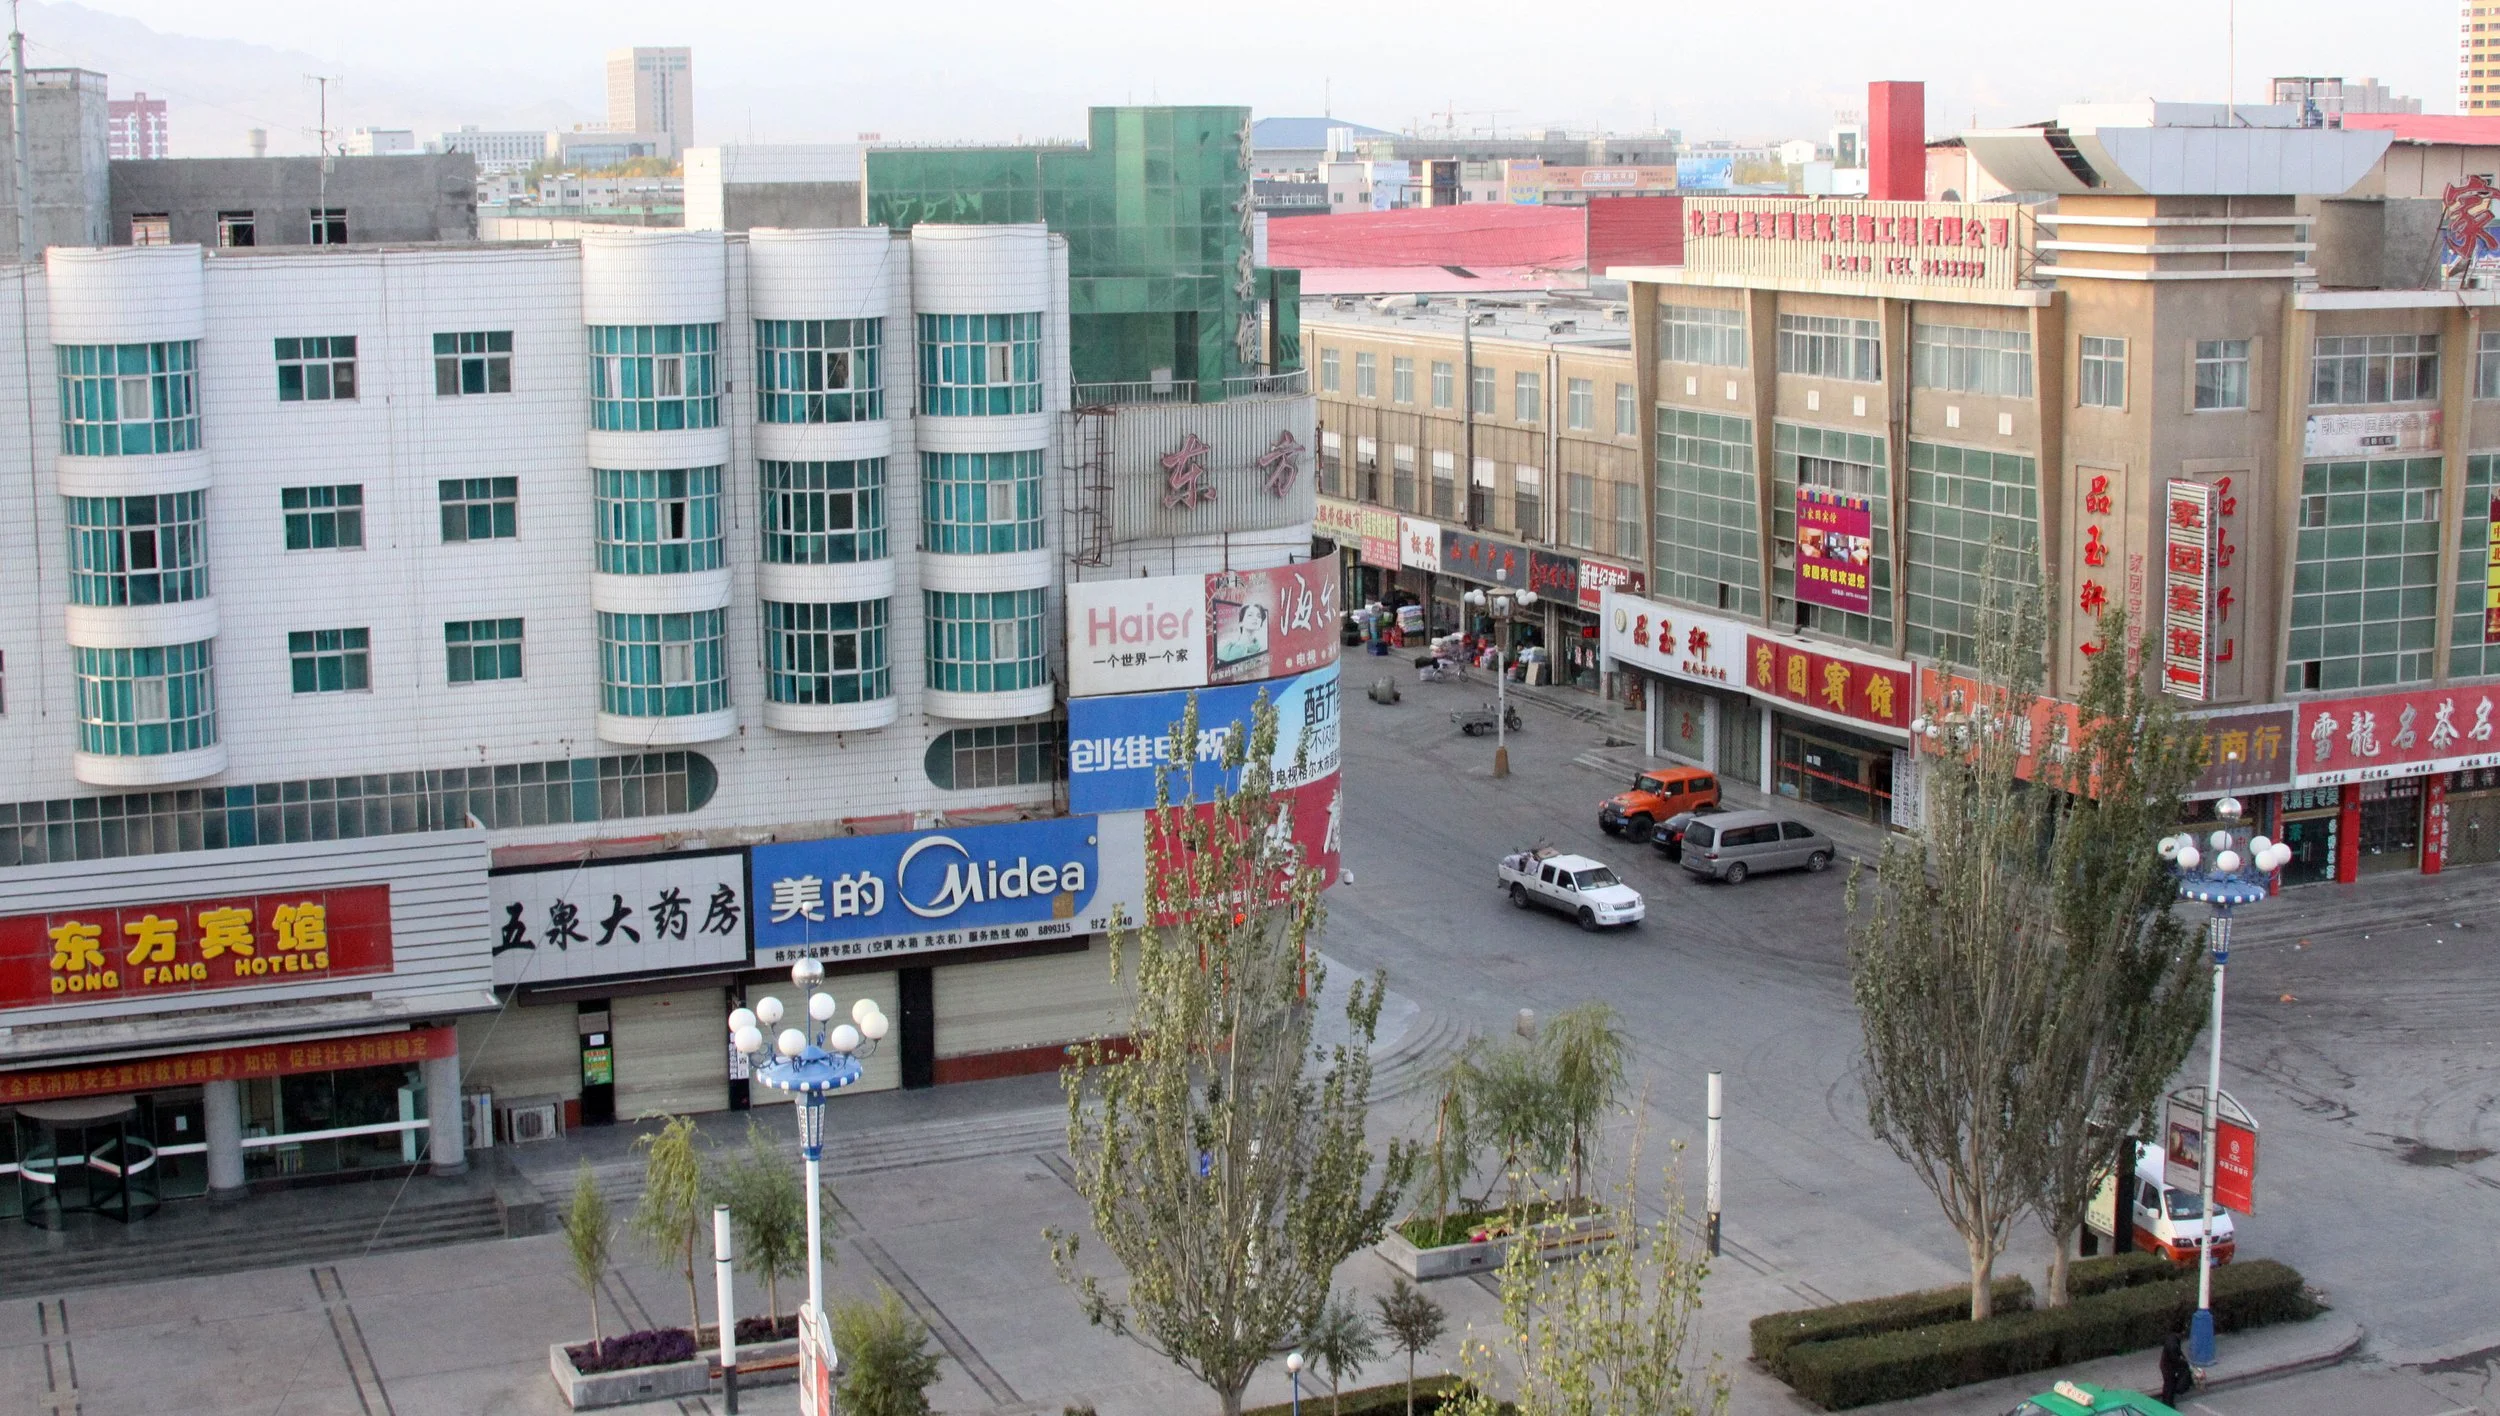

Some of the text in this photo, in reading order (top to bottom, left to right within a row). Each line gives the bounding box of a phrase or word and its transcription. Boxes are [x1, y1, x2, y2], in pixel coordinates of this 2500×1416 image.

[1885, 257, 1912, 276] TEL
[1162, 430, 1305, 510] 东方
[2080, 475, 2110, 622] 品玉轩
[1803, 563, 1866, 589] 家园宾馆欢迎您
[2168, 500, 2202, 657] 家园宾馆
[1088, 603, 1194, 647] Haier
[1634, 614, 1711, 662] 品玉轩
[1093, 648, 1189, 671] 一个世界一个家
[1296, 649, 1317, 667] 电视
[771, 870, 885, 924] 美的
[928, 857, 1086, 907] Midea
[49, 901, 328, 971] 东方宾馆
[492, 883, 741, 957] 五泉大药房
[968, 927, 1011, 944] 服务热线
[1014, 926, 1029, 939] 400
[1038, 922, 1072, 937] 8899315
[51, 951, 329, 994] DONG FANG HOTELS
[289, 1036, 428, 1069] 促进社会和谐稳定
[2219, 1160, 2249, 1178] 中国工商银行
